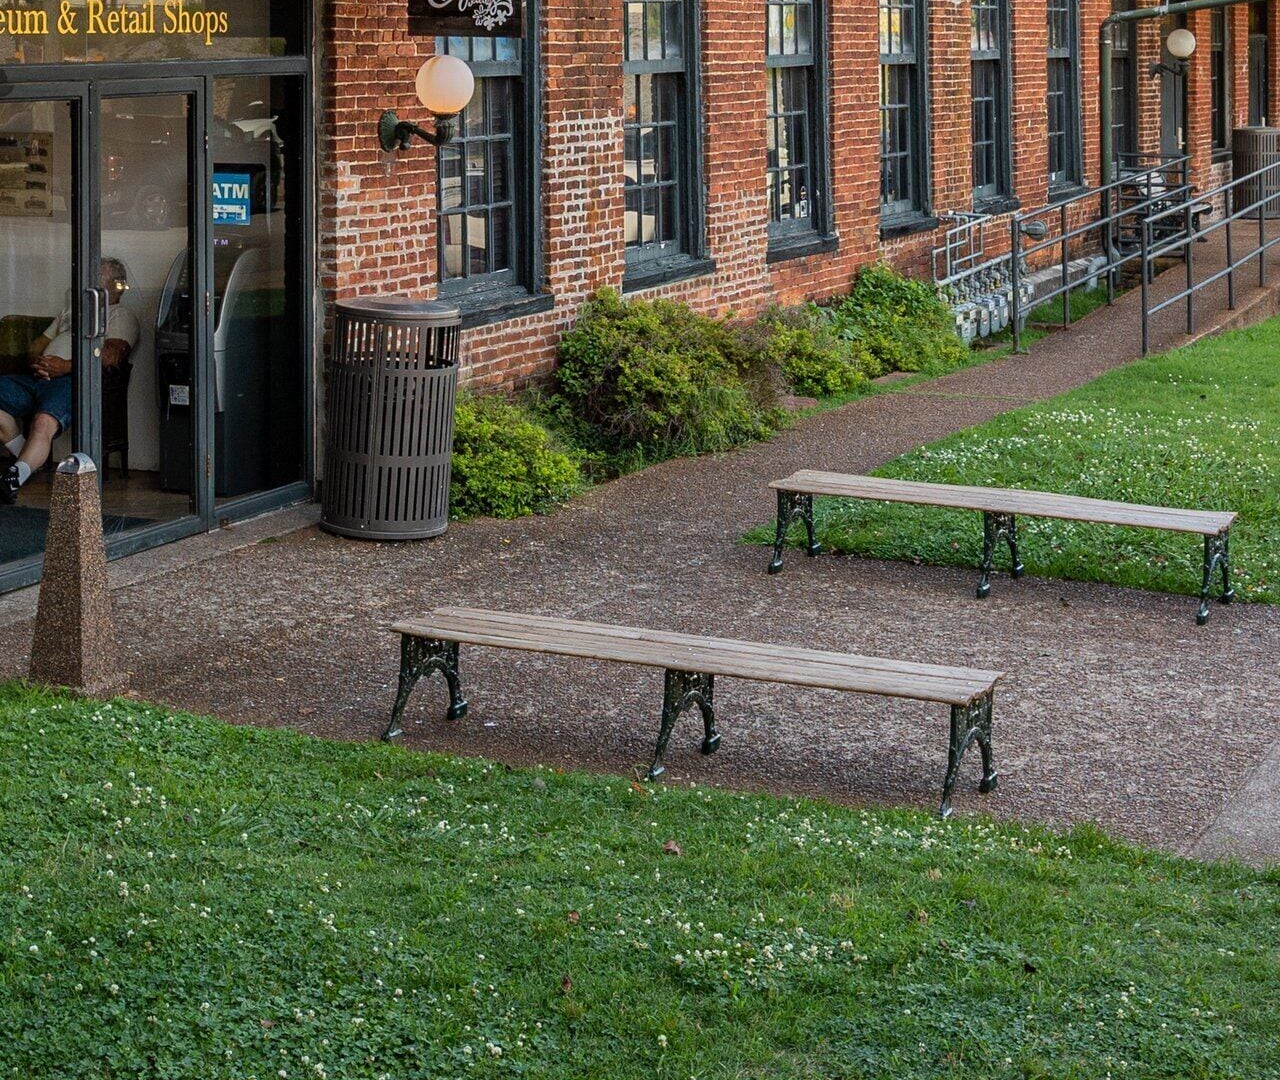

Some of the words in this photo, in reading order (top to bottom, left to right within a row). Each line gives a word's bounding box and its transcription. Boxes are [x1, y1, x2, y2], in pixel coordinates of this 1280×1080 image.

[57, 0, 79, 35] &
[162, 0, 228, 46] Shops
[213, 183, 249, 199] ATM
